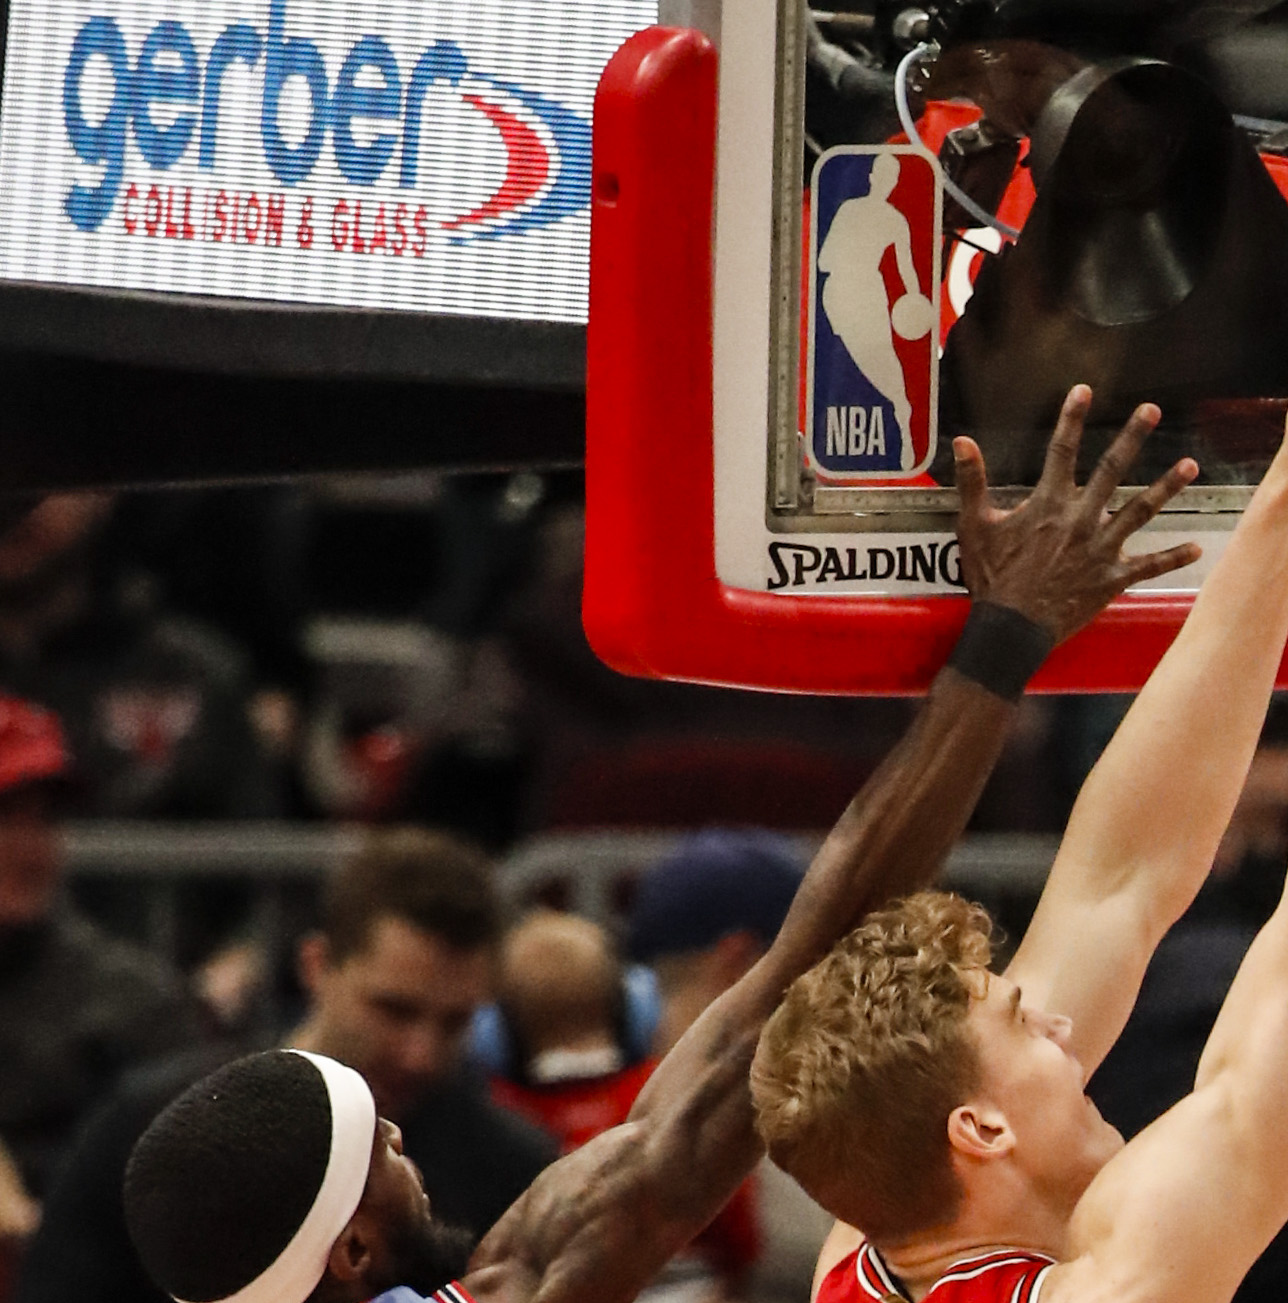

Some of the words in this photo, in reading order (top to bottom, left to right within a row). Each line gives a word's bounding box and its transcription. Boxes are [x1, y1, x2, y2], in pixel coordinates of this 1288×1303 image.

[63, 0, 468, 232] gerber
[123, 182, 285, 247] COLLISION
[297, 196, 313, 250] &
[332, 198, 428, 258] GLASS
[826, 406, 887, 456] NBA
[767, 540, 964, 590] SPALDING
